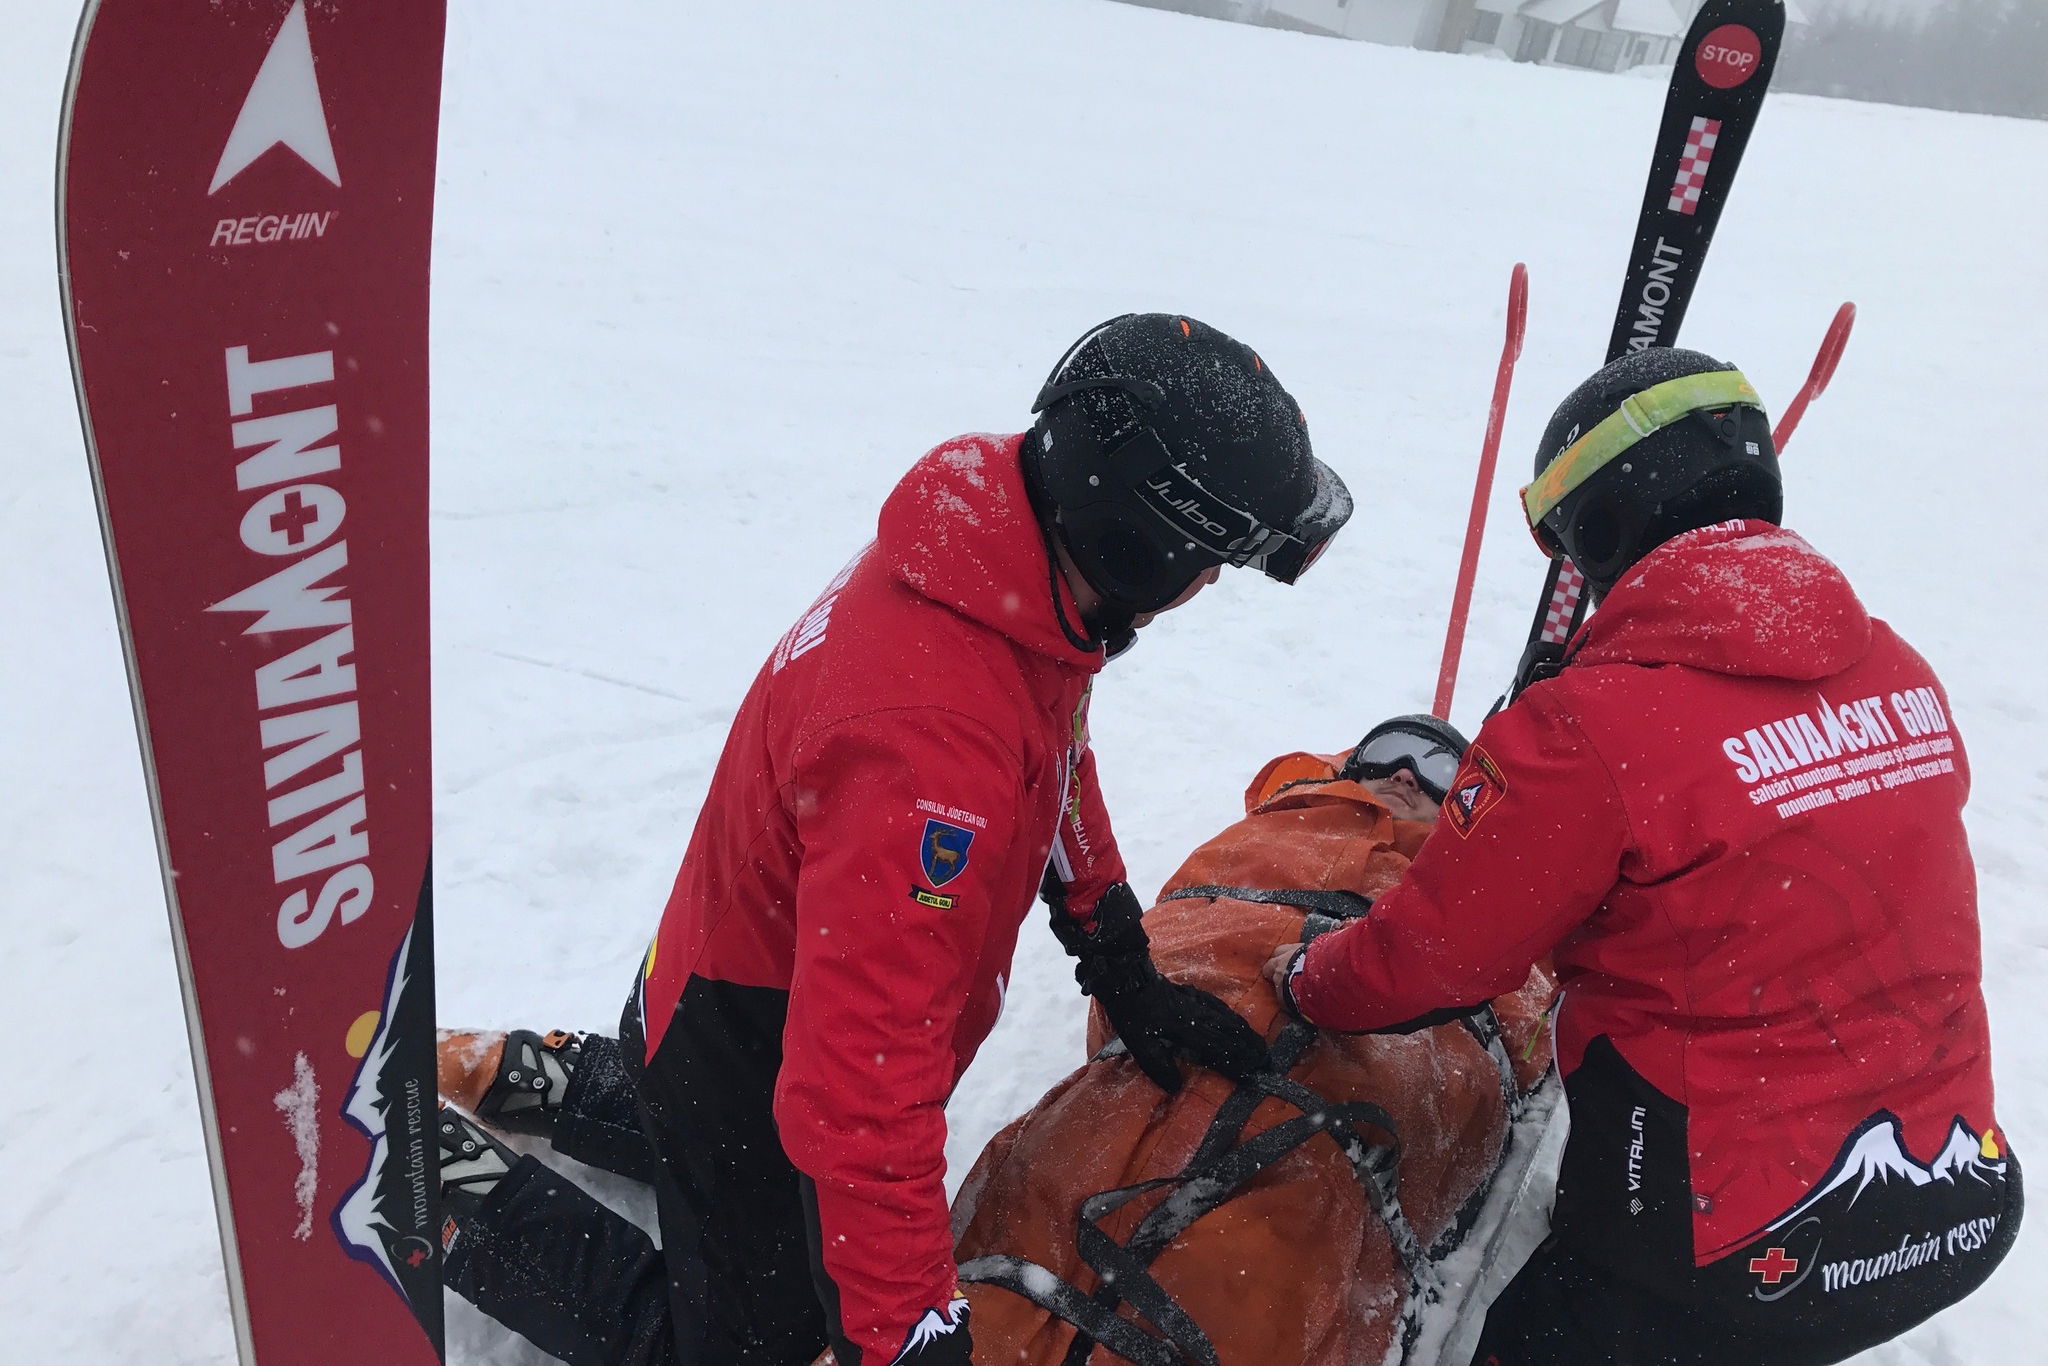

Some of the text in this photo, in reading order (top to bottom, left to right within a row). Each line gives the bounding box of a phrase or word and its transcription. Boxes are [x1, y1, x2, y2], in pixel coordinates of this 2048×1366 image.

[1702, 44, 1753, 68] STOP
[209, 211, 331, 247] REGHIN
[1626, 236, 1683, 354] AMONT
[1146, 479, 1227, 537] Julbo
[202, 344, 374, 949] SALVAMONT
[1722, 686, 1948, 783] SALVAMONT GORJ
[1792, 763, 1847, 790] montane,
[405, 1078, 428, 1229] mountain rescue
[1628, 1106, 1646, 1191] VITALINI
[1822, 1232, 1941, 1292] mountain
